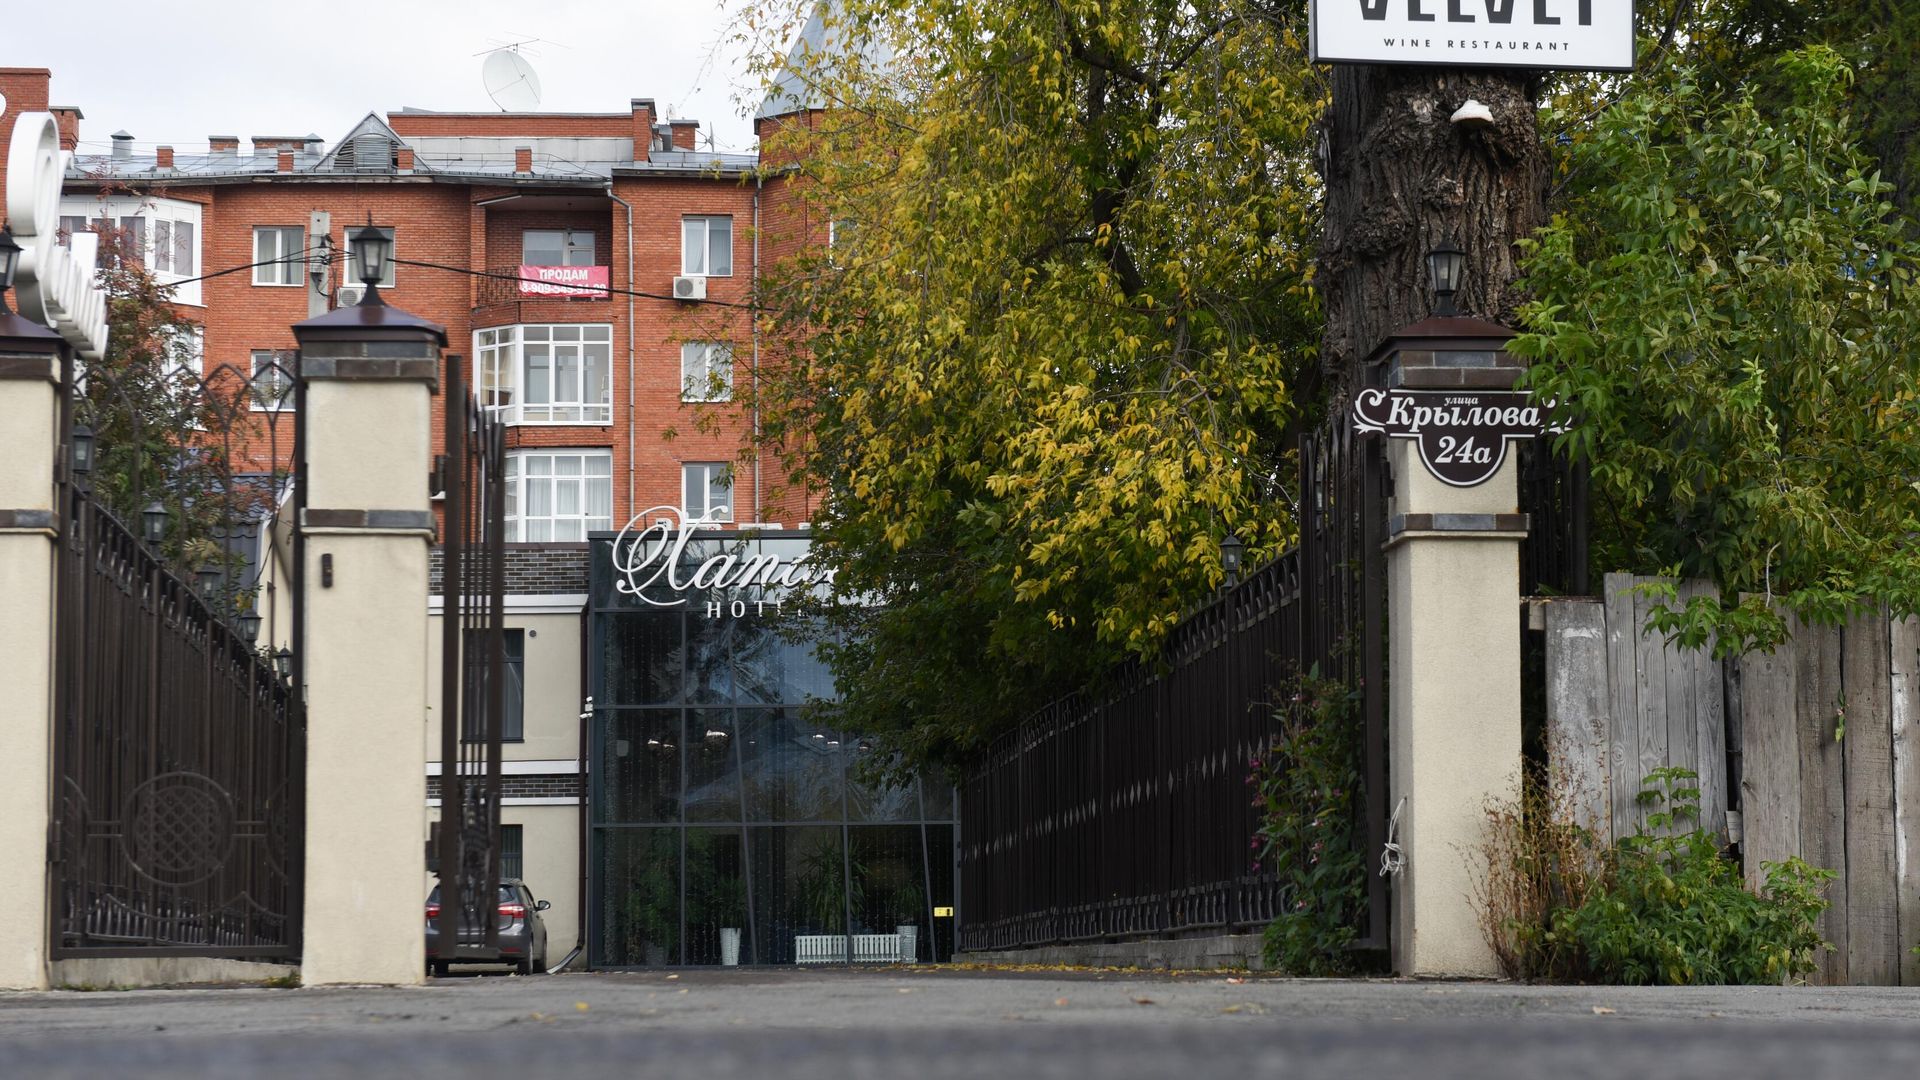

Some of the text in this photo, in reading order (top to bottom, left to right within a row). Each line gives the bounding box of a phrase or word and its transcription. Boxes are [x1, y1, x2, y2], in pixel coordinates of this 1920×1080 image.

[1383, 37, 1571, 52] WINE RESTAURANT
[539, 269, 588, 282] ПРОДАМ
[1443, 397, 1479, 407] улица
[1386, 396, 1541, 433] Крылова
[1434, 435, 1492, 464] 24а
